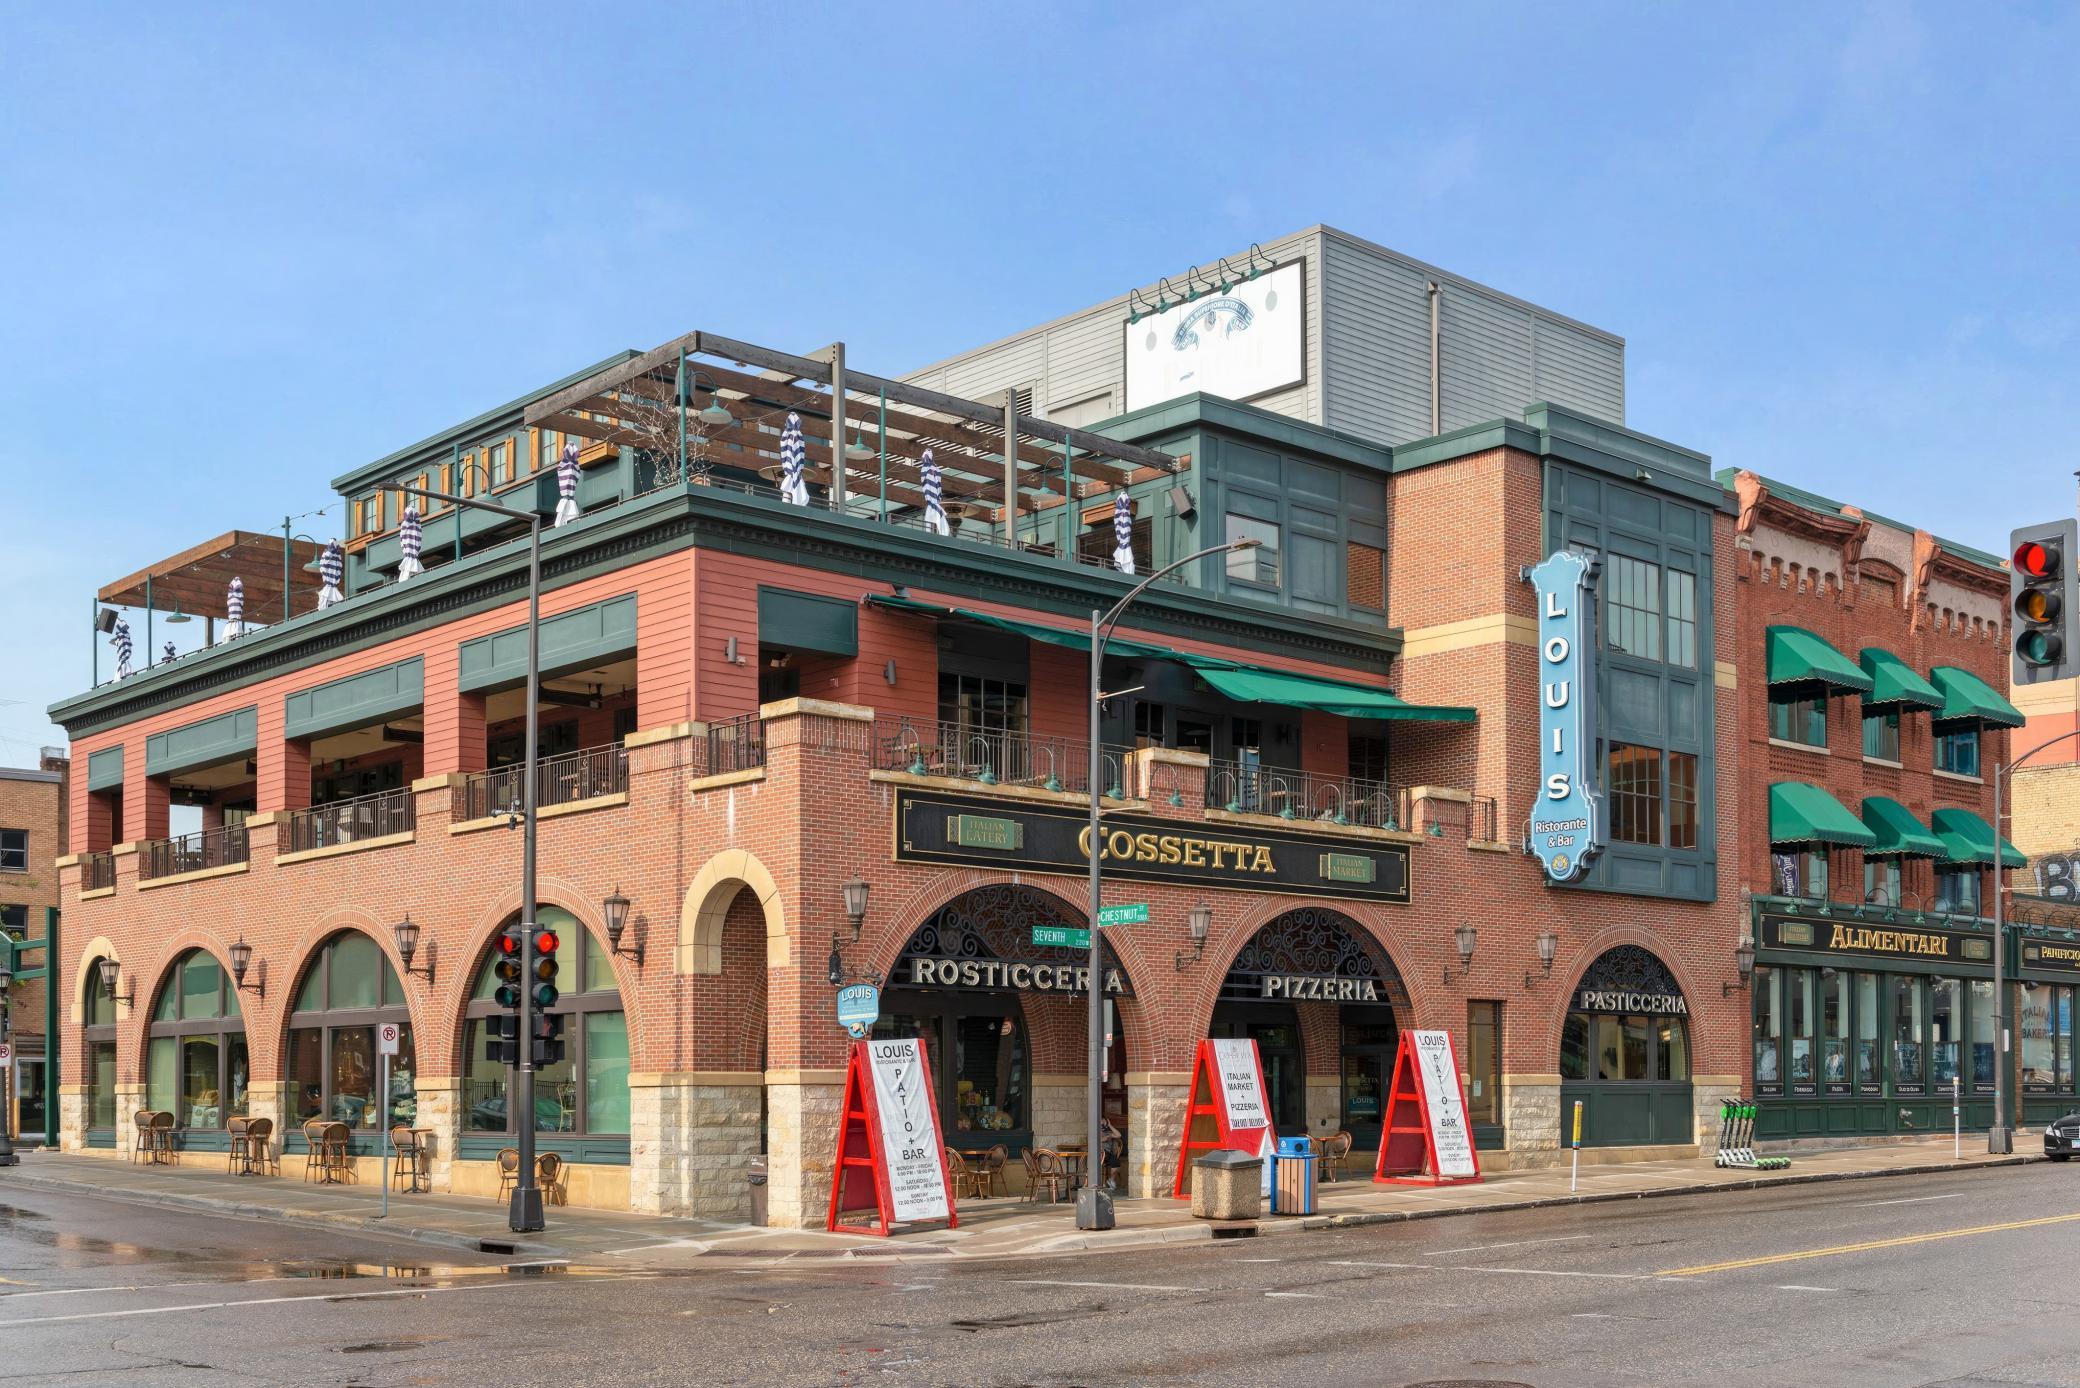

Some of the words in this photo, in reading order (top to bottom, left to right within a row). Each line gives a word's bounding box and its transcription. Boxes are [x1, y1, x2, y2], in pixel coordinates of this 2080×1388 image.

[1545, 591, 1571, 800] LOUIS
[970, 820, 1005, 831] ITALIAN
[1535, 818, 1587, 833] Ristorante
[966, 830, 1008, 844] EATERY
[1548, 837, 1556, 848] &
[1557, 834, 1575, 847] Bar
[1078, 825, 1277, 874] COSSETTA
[1333, 866, 1367, 879] MARKET
[1100, 908, 1138, 922] CHESTNUT
[1034, 929, 1066, 943] SEVENTH
[1829, 924, 1949, 956] ALIMENTARI
[911, 957, 1124, 993] ROSTICCERA
[841, 988, 873, 1002] LOUIS
[1261, 976, 1378, 1001] PIZZERIA
[1581, 991, 1687, 1014] PASTICCERIA
[1419, 1035, 1446, 1046] LOUIS
[875, 1045, 913, 1059] LOUIS
[1226, 1072, 1251, 1080] ITALIAN
[1433, 1054, 1448, 1105] PATIO
[1228, 1082, 1254, 1091] MARKET
[895, 1069, 913, 1132] PATIO
[1231, 1103, 1259, 1111] PIZZERIA
[1352, 1097, 1374, 1105] LOUIS
[1441, 1118, 1457, 1127] BAR
[902, 1148, 926, 1160] BAR
